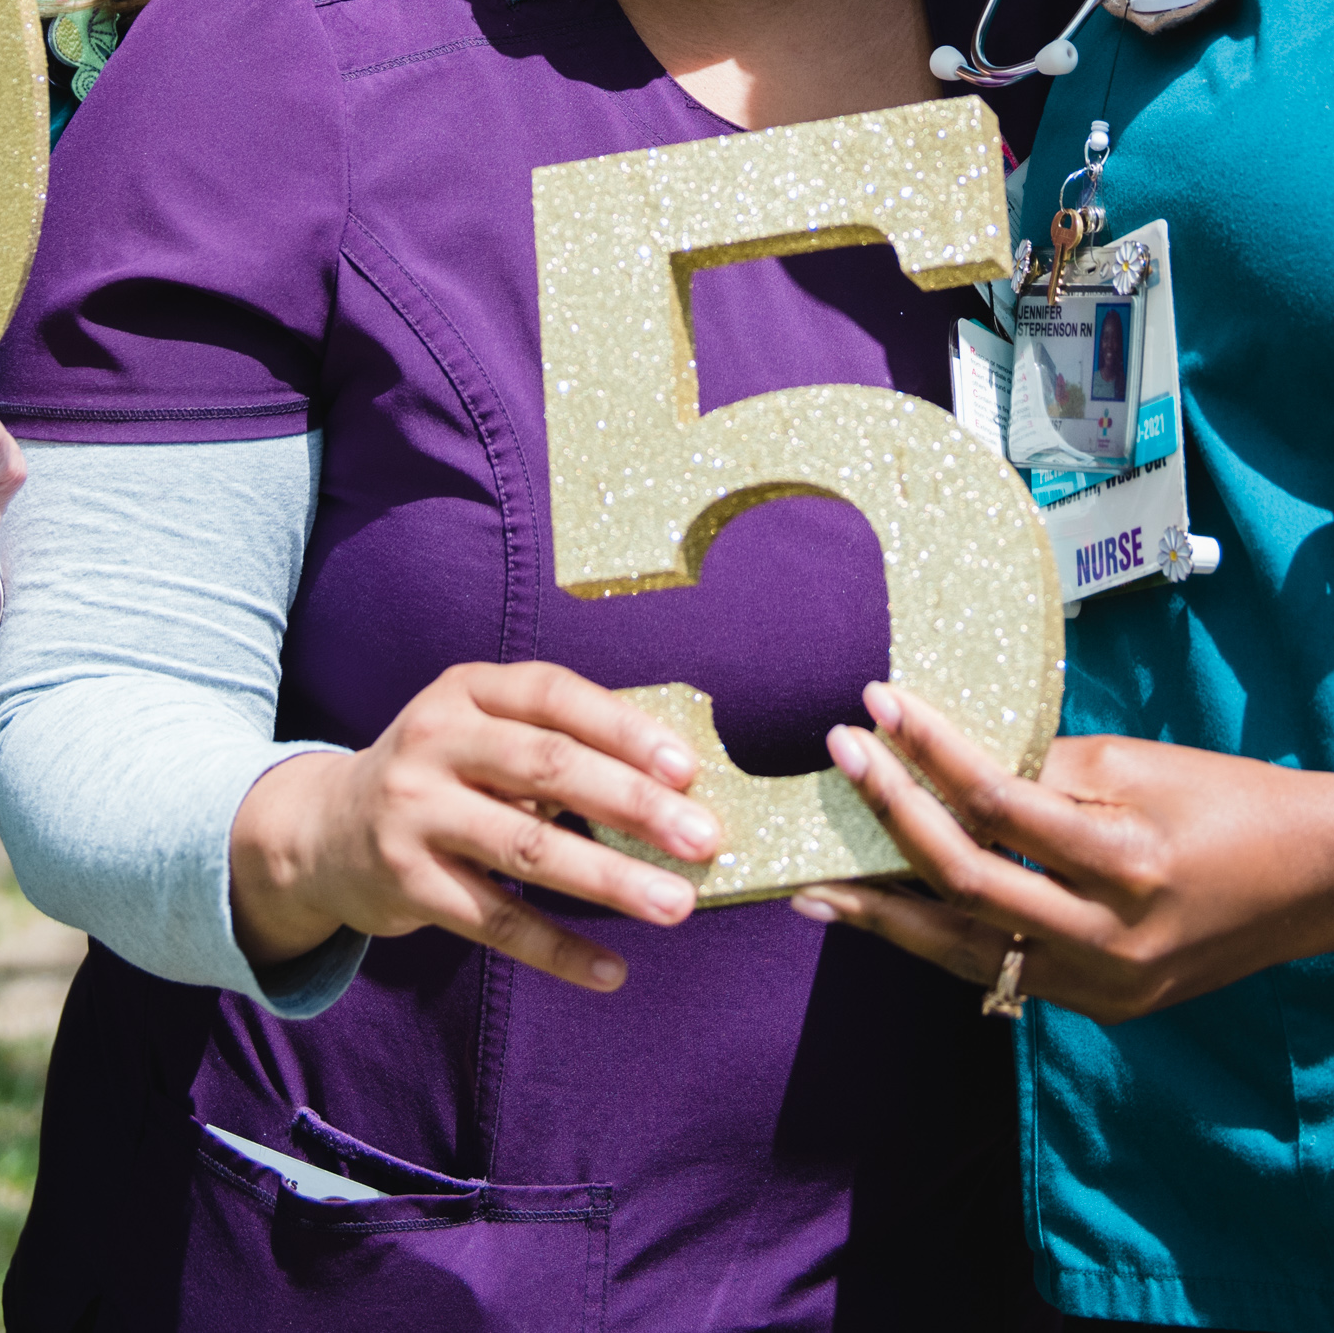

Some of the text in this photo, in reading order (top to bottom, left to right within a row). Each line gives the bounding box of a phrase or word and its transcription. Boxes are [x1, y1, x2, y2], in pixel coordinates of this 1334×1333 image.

[1018, 305, 1062, 320] JENNIFER
[1017, 322, 1093, 337] STEPHENSON RN
[1076, 526, 1144, 587] NURSE
